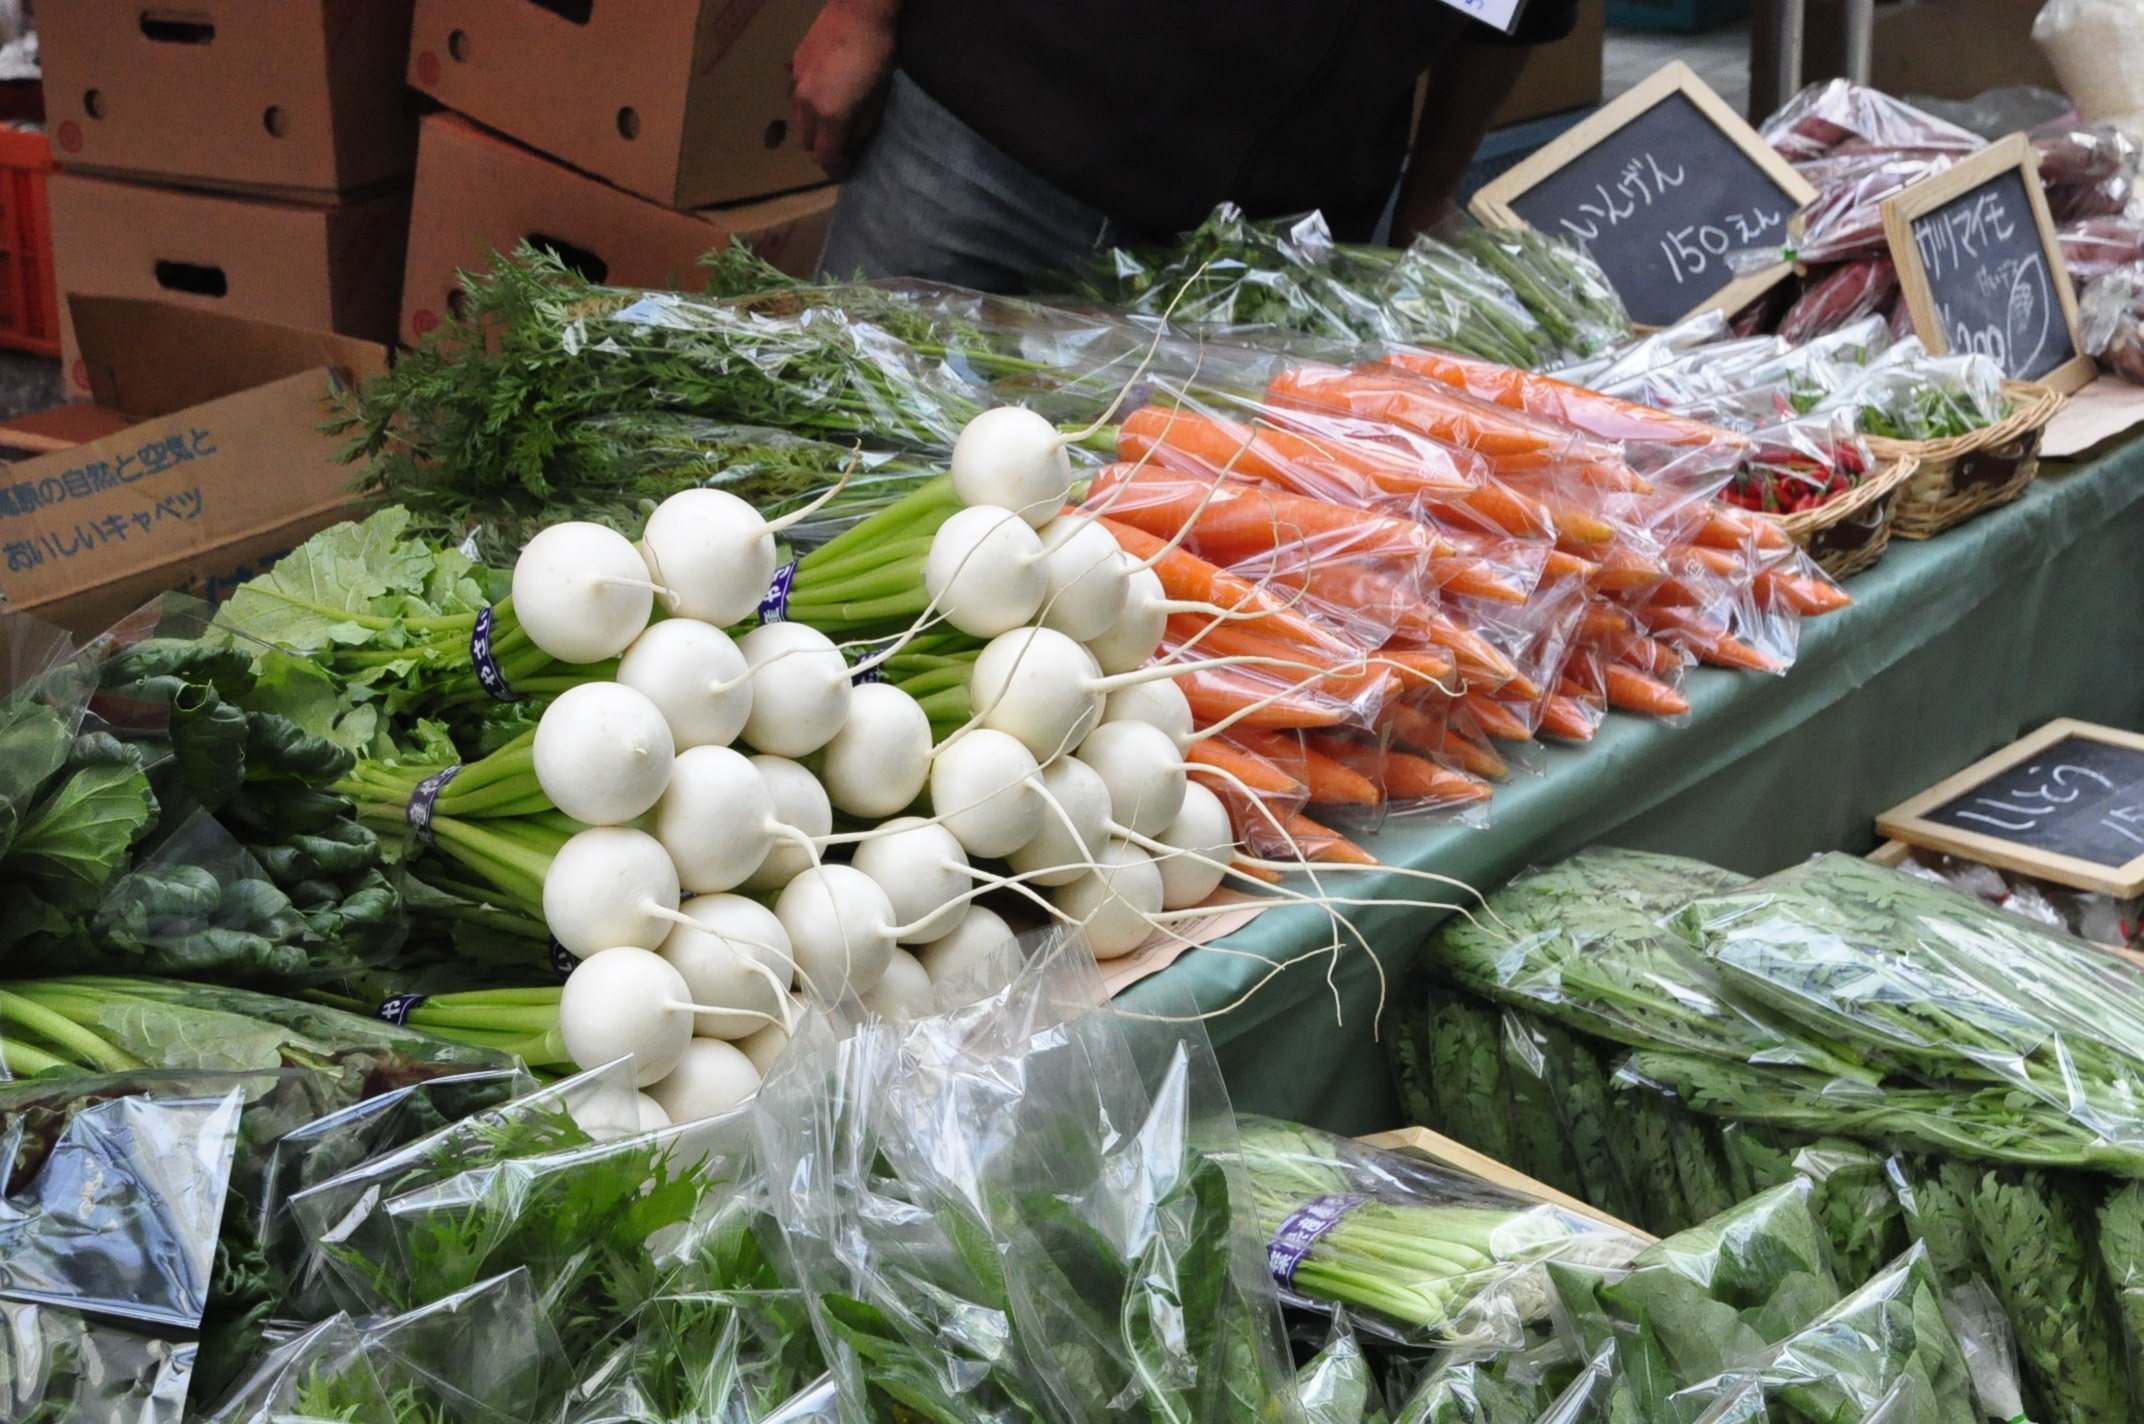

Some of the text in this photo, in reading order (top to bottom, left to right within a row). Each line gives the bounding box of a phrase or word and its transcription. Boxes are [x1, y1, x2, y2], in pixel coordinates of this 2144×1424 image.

[1559, 152, 1685, 239] いんげん
[1659, 207, 1781, 284] 150えん
[3, 487, 203, 572] おいしいキャベツ
[473, 610, 496, 686] やさい
